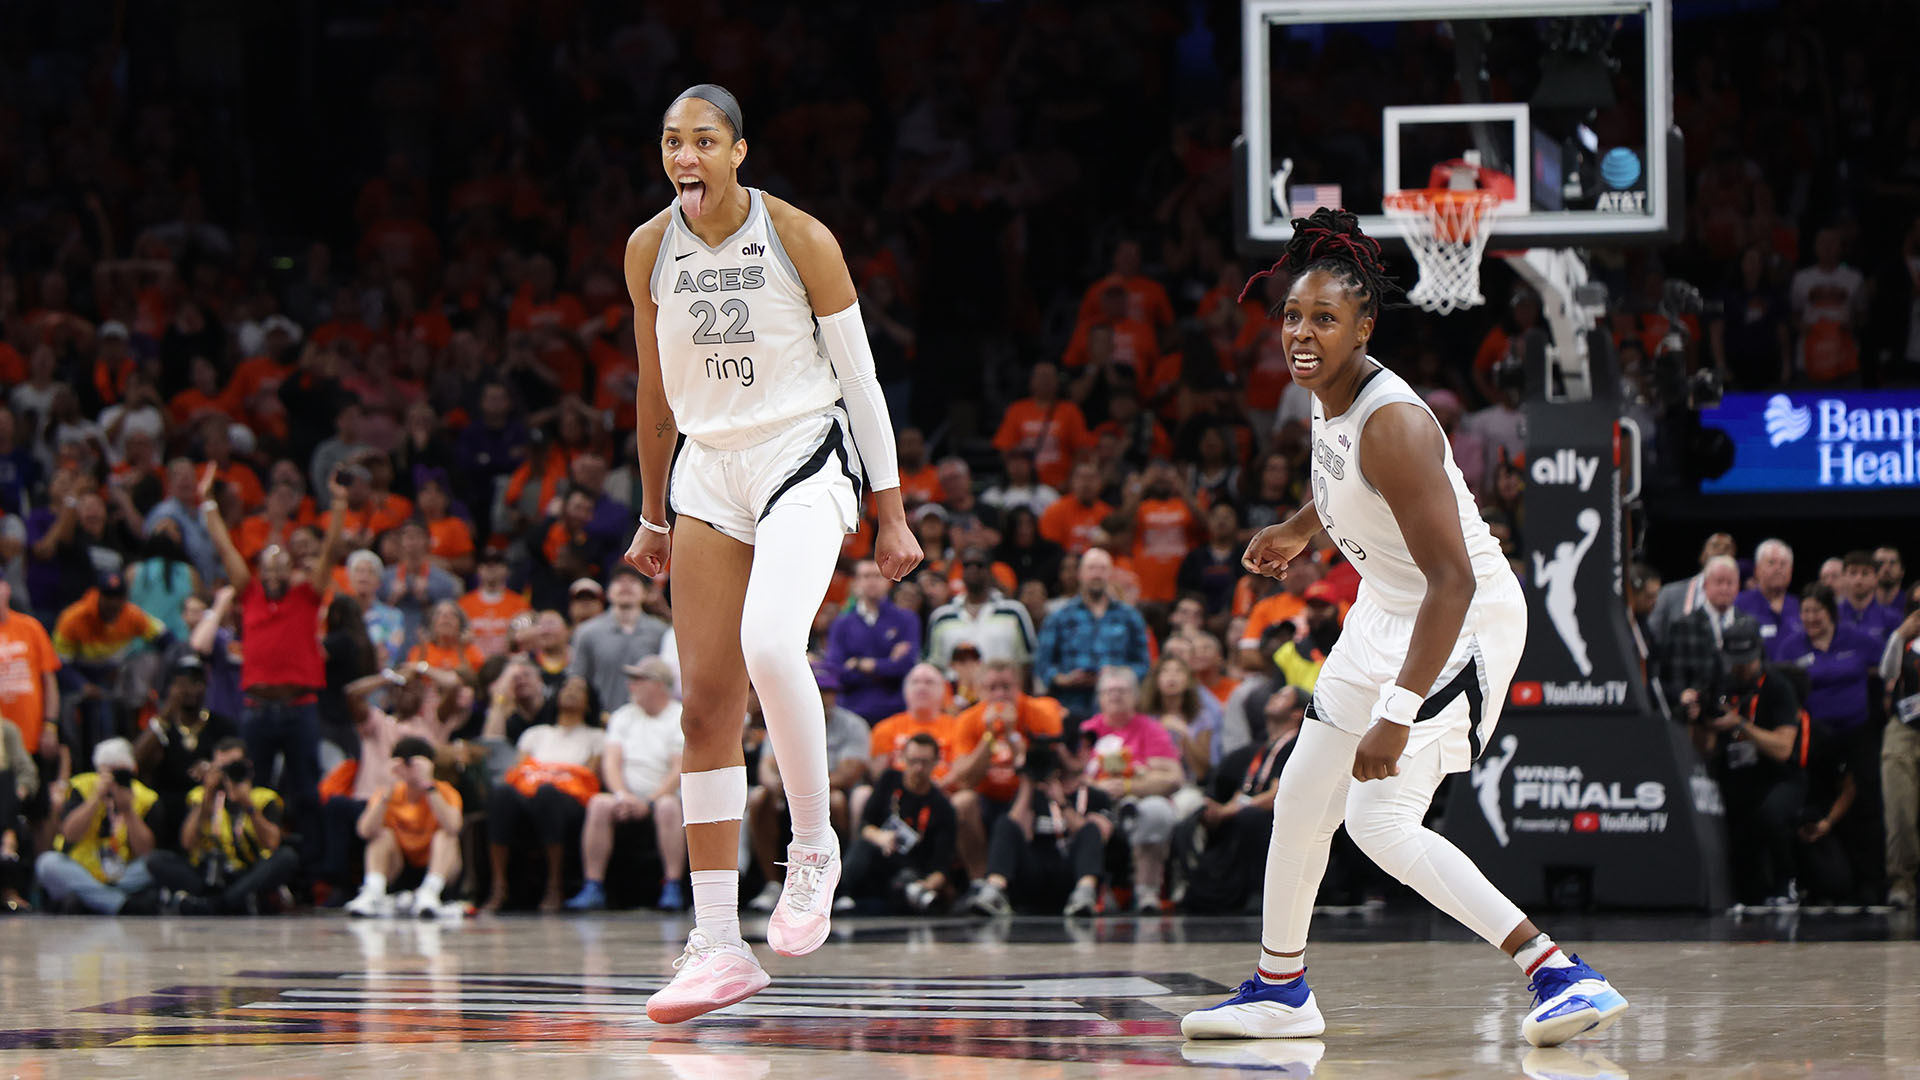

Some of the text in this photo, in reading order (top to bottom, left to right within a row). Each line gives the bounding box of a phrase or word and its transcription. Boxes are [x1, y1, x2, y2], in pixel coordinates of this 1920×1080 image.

[1596, 191, 1646, 212] AT&T
[741, 243, 766, 257] ally
[674, 266, 765, 293] ACES
[688, 298, 755, 345] 22
[705, 352, 755, 387] ring
[1337, 434, 1352, 452] ally
[1531, 449, 1599, 492] ally
[1543, 681, 1628, 706] YouTube TV
[1513, 765, 1583, 782] WNBA
[1513, 782, 1666, 810] FINALS
[1600, 813, 1649, 833] YouTube
